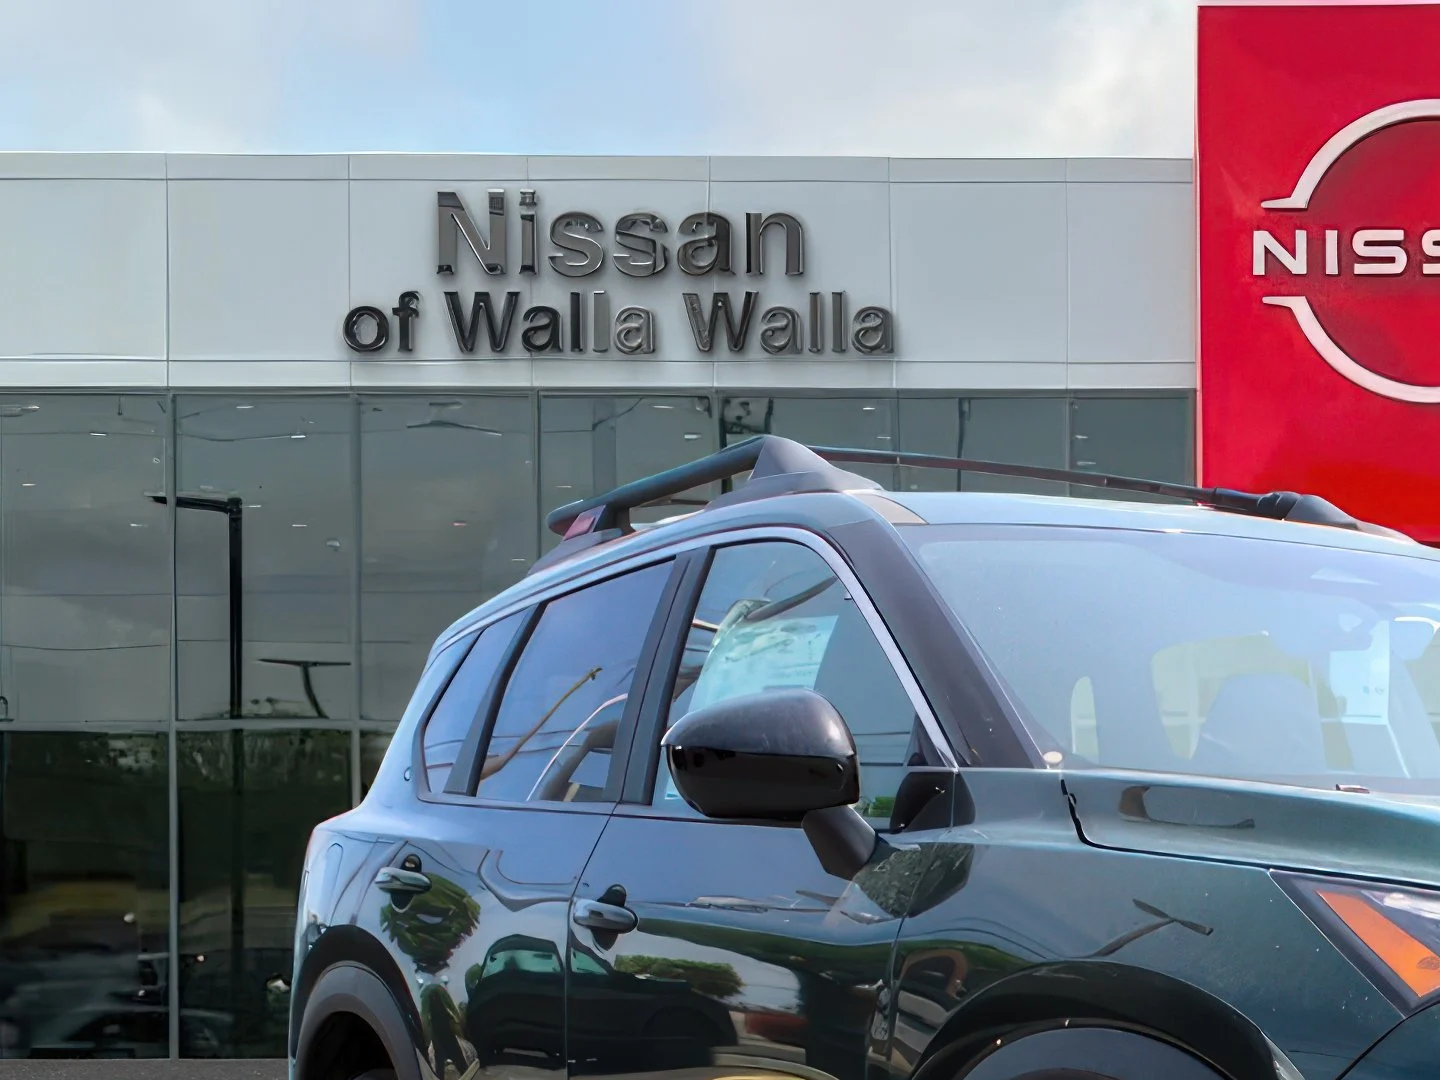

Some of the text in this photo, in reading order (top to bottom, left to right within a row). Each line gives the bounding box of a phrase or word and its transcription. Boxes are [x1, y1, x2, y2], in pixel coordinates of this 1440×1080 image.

[436, 188, 805, 278] Nissan
[342, 290, 896, 355] of Walla Walla
